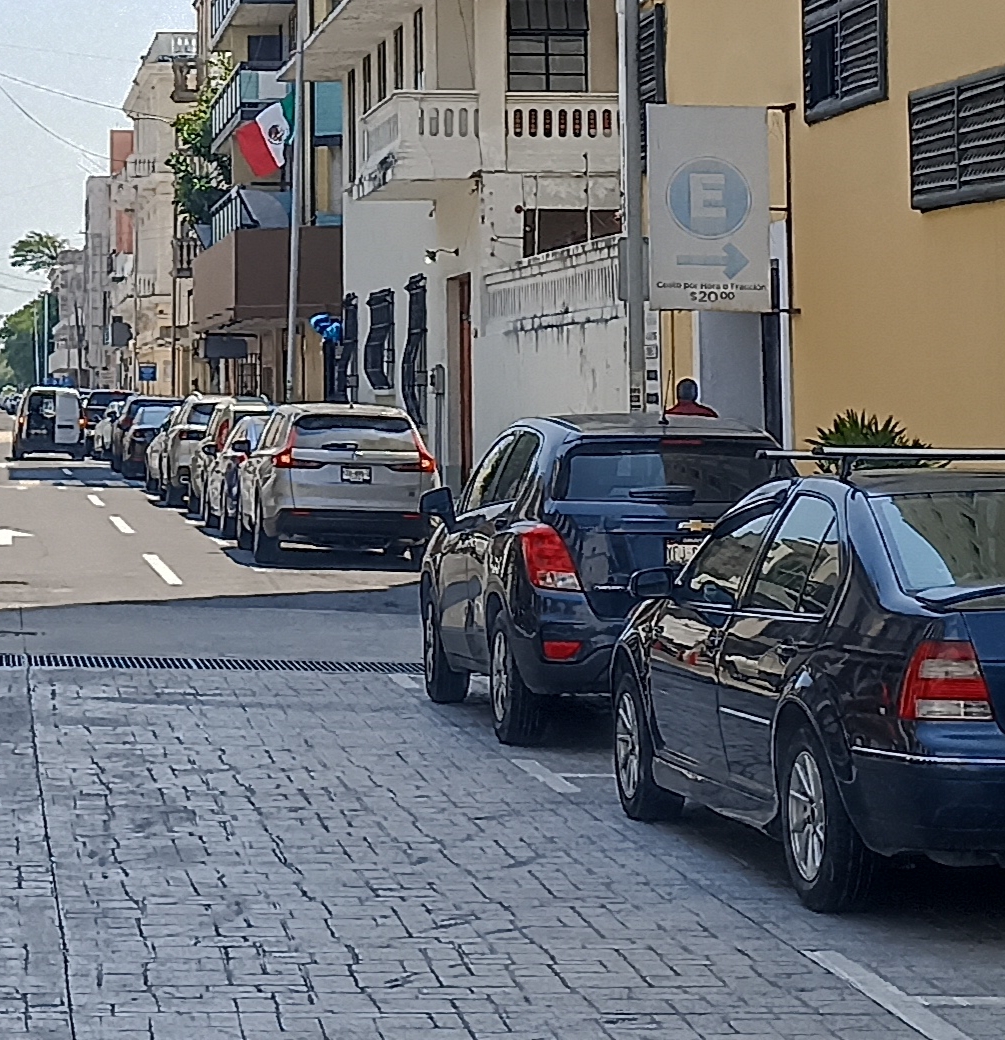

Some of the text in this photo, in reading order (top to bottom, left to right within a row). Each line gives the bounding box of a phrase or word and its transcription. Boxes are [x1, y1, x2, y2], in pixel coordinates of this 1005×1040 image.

[689, 173, 727, 218] E
[683, 282, 698, 290] por
[700, 282, 721, 290] Hora
